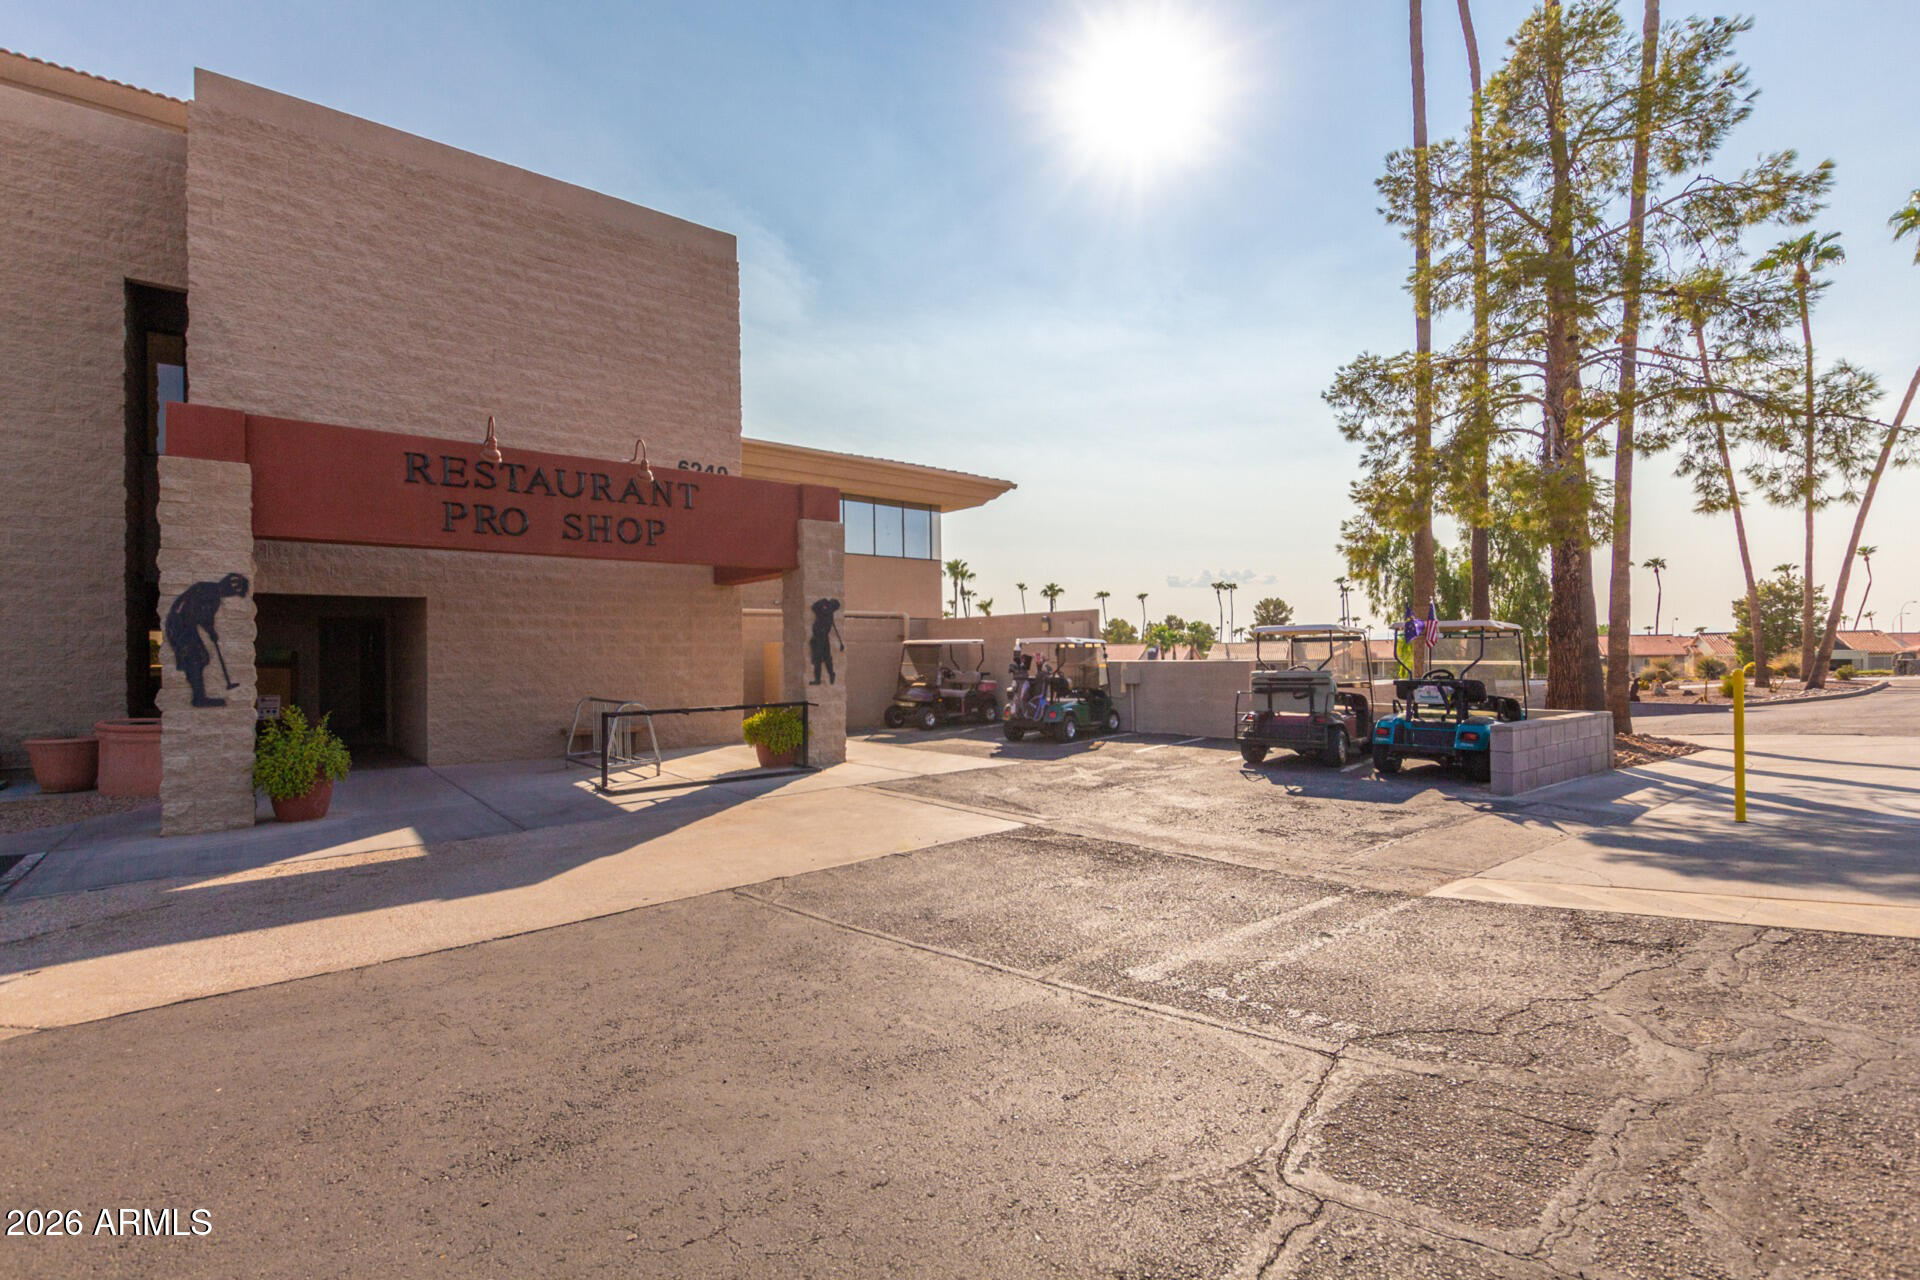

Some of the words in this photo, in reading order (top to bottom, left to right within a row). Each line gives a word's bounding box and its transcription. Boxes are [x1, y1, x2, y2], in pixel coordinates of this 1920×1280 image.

[404, 452, 699, 509] RESTAURANT
[442, 501, 530, 536] PRO
[562, 514, 666, 546] SHOP
